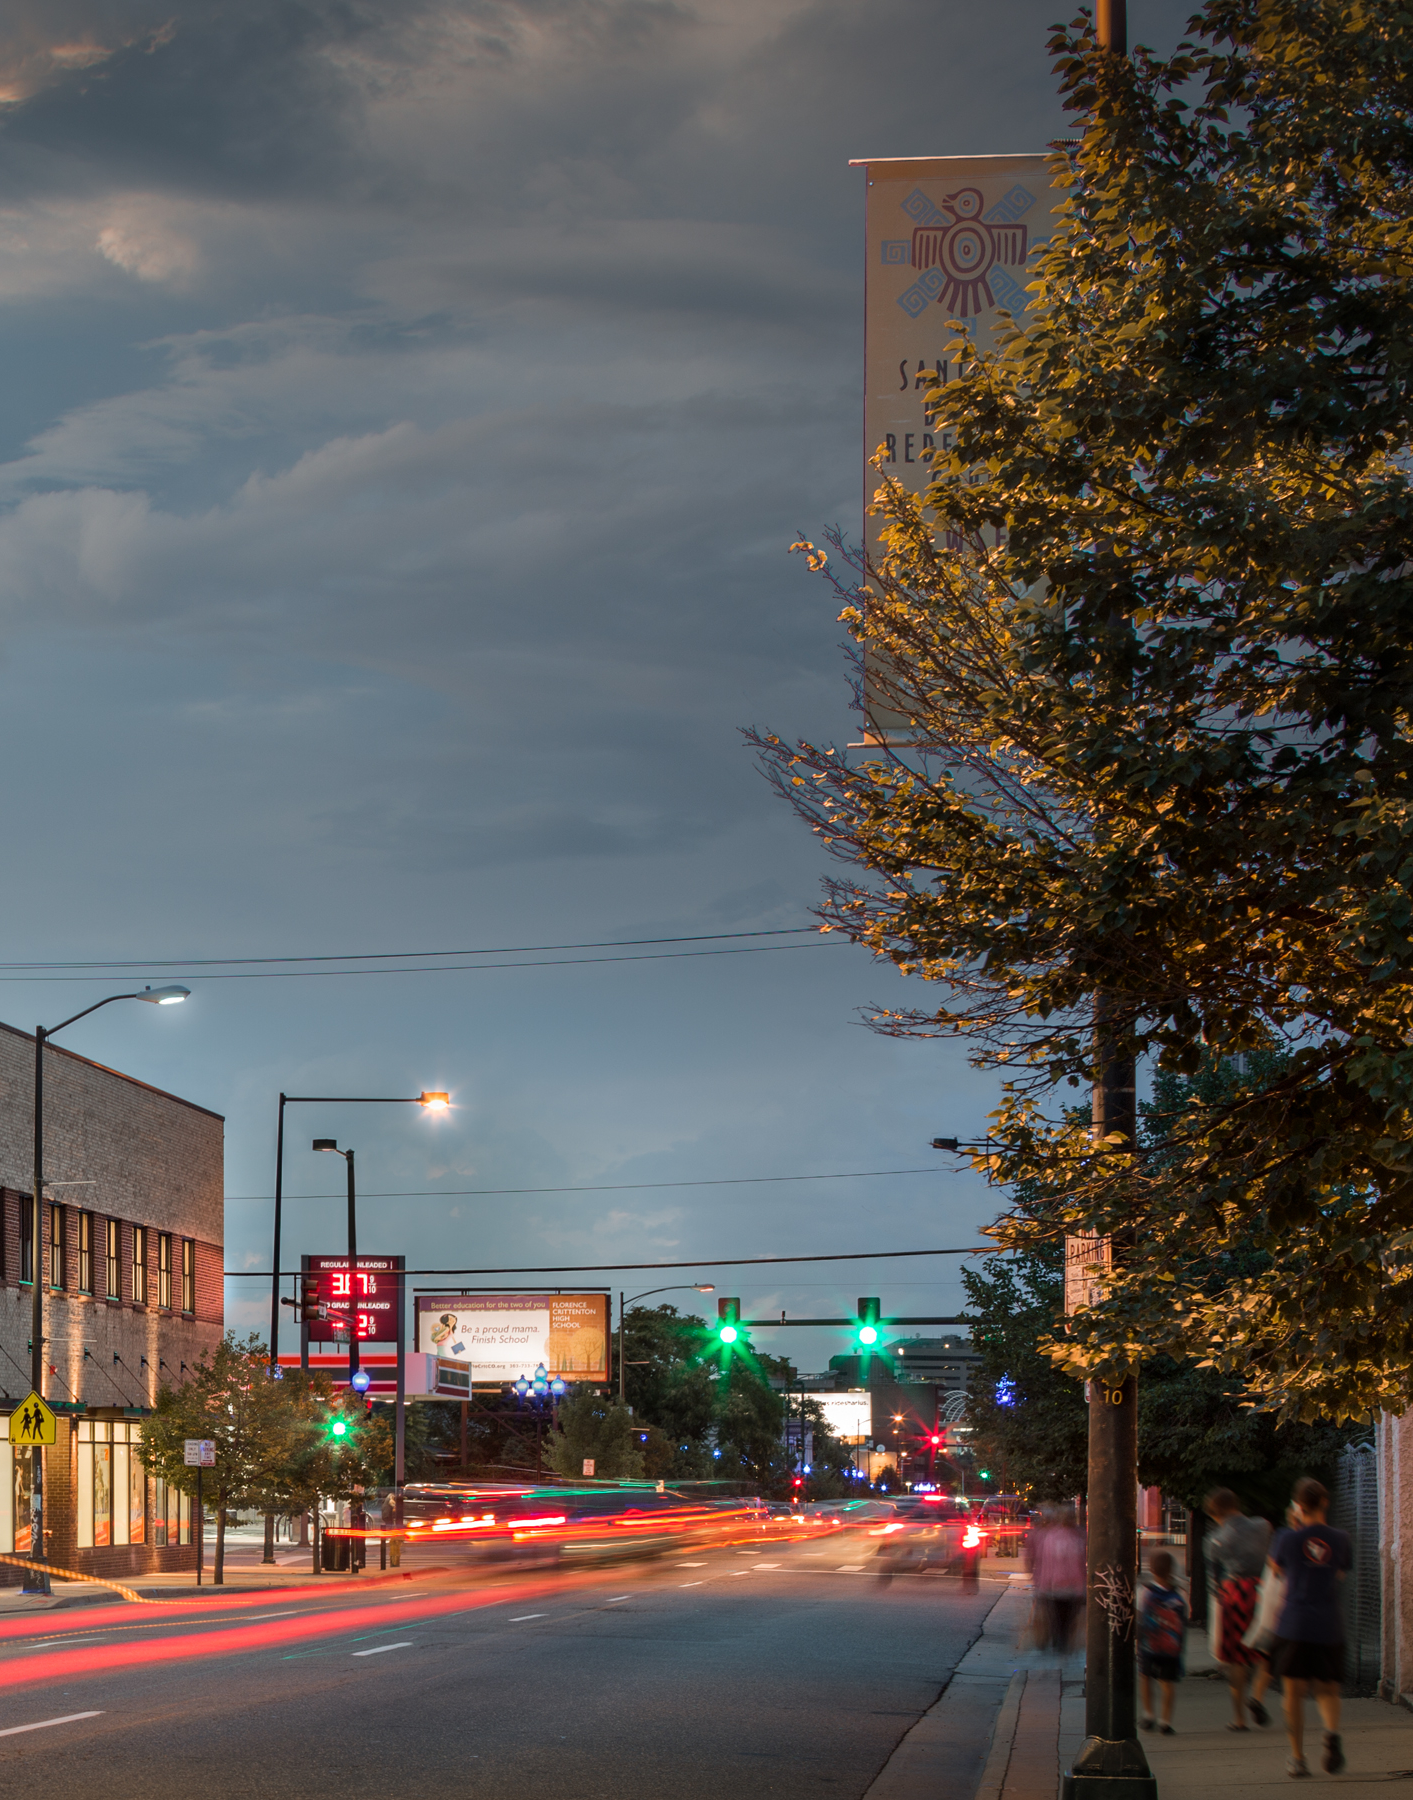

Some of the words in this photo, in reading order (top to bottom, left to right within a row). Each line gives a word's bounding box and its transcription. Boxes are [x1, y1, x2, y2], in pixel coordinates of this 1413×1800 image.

[1070, 1240, 1105, 1265] PARKING
[356, 1261, 388, 1269] NLEADED
[461, 1325, 473, 1333] Be
[482, 1325, 510, 1335] proud
[471, 1335, 496, 1344] Finish
[499, 1335, 529, 1344] School
[1103, 1389, 1123, 1405] 10
